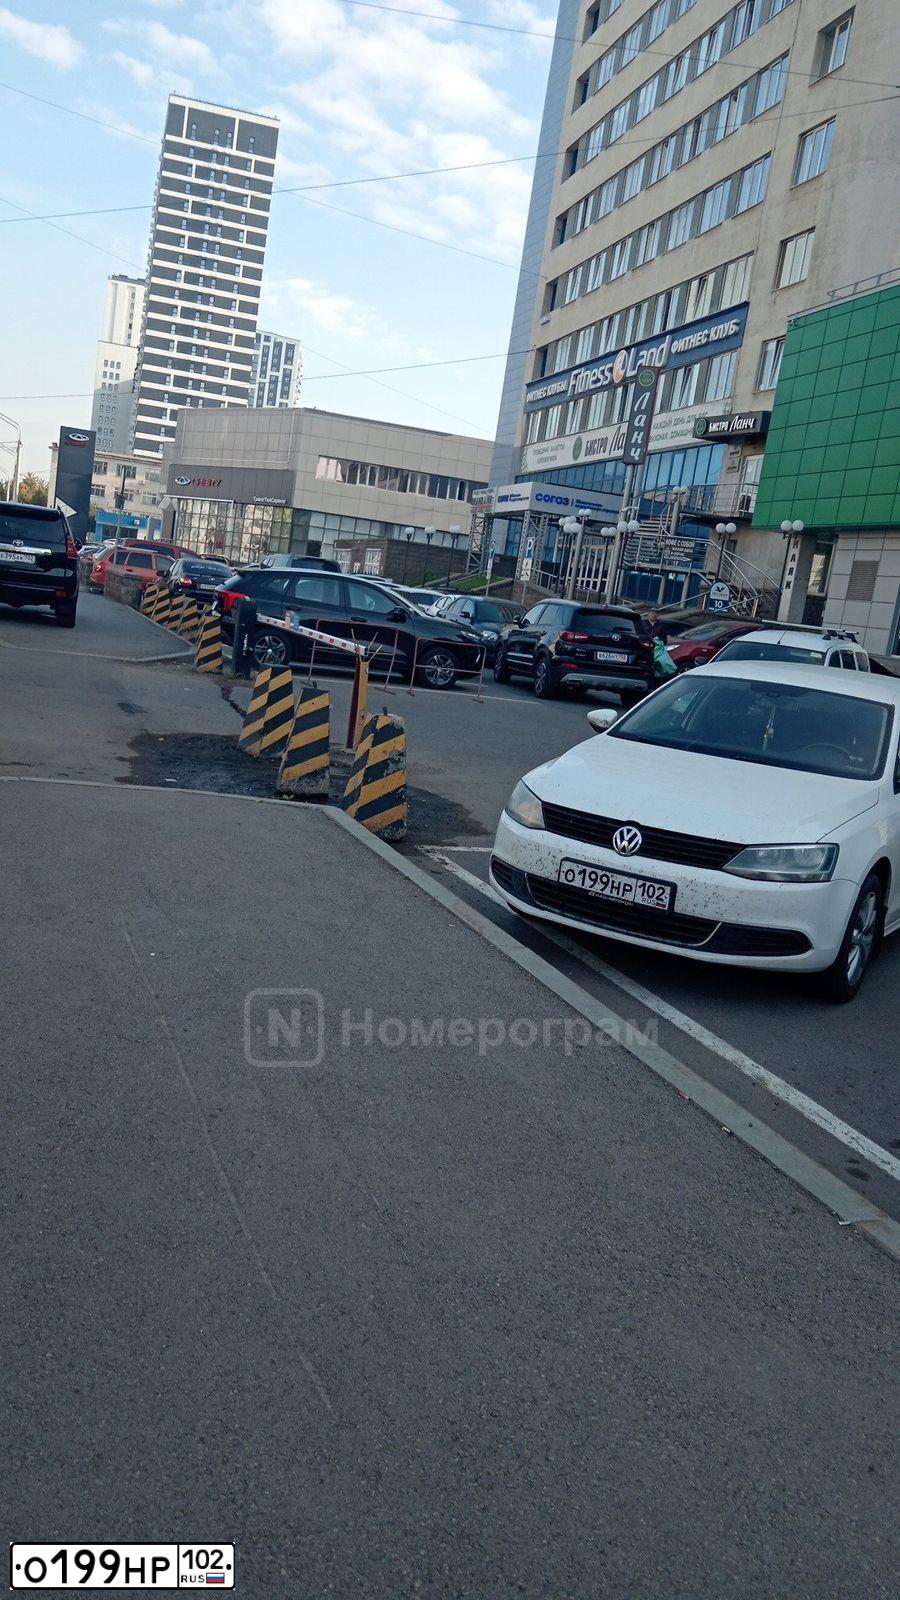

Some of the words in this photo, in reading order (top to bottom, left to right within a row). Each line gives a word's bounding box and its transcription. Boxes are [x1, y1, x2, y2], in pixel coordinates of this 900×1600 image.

[671, 330, 710, 354] ФИТНЕС
[708, 318, 740, 344] КЛУБ
[568, 362, 614, 396] Fitness
[626, 335, 672, 378] Land
[584, 437, 609, 457] БИСТРО
[609, 425, 627, 455] Ла
[630, 392, 651, 461] Ланч
[708, 421, 728, 432] БИСТРО
[729, 415, 755, 432] Ланч
